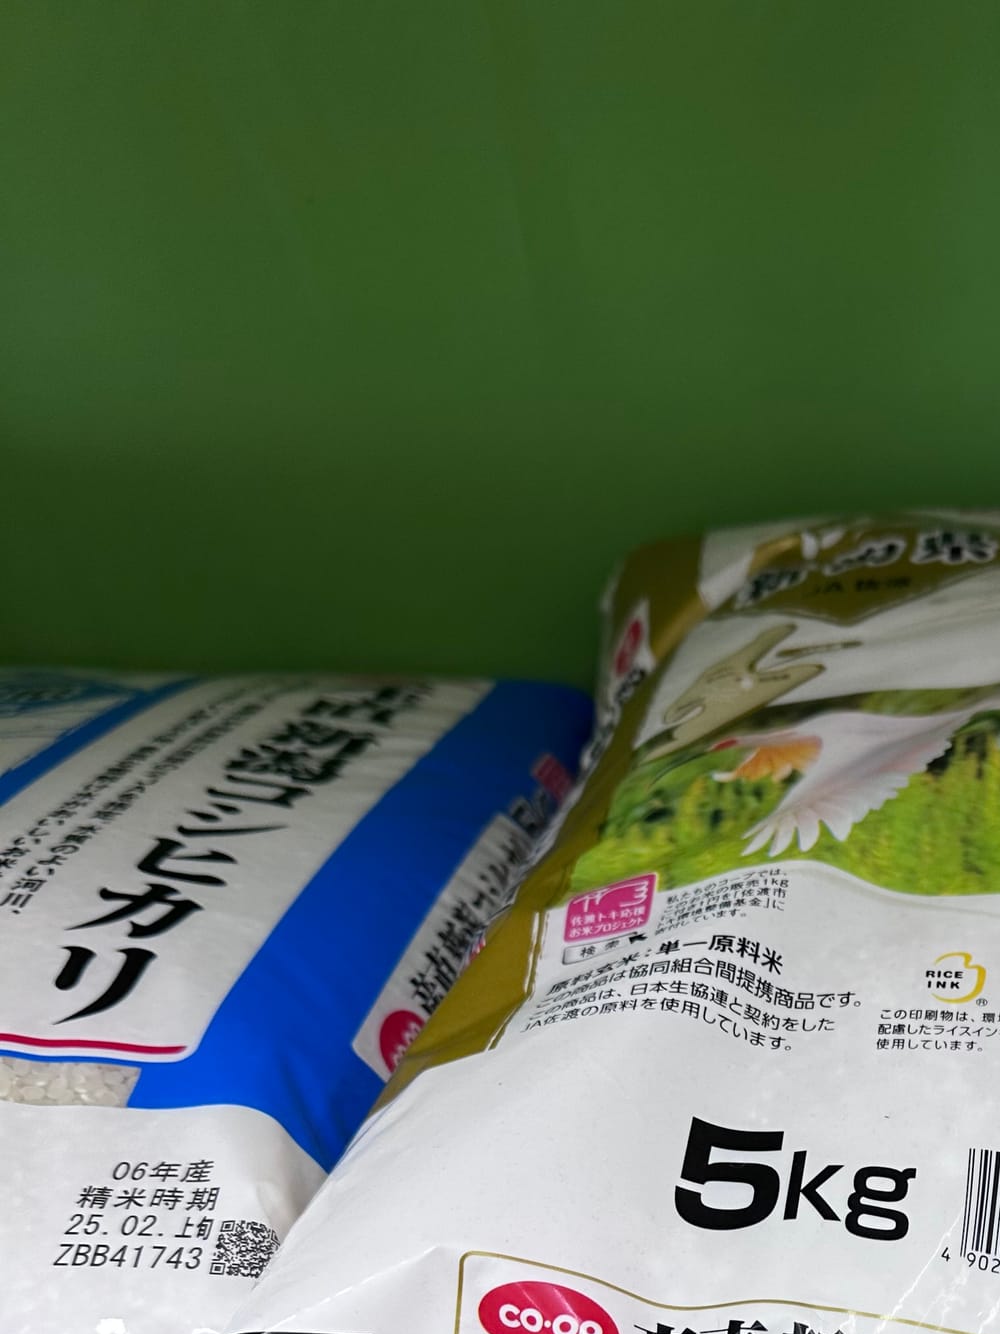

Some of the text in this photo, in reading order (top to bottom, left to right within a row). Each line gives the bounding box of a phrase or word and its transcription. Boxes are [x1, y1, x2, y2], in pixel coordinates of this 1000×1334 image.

[925, 969, 964, 980] RICE
[926, 980, 961, 990] INK
[528, 980, 836, 1033] この商品は、日本生協連と契約をした
[519, 996, 792, 1052] JA佐渡の原料を使用しています。
[876, 1038, 985, 1053] 使用しています。
[111, 1159, 216, 1184] 06年産
[674, 1115, 917, 1241] 5kg
[75, 1185, 221, 1212] 精米時期
[52, 1243, 204, 1270] ZBB41743
